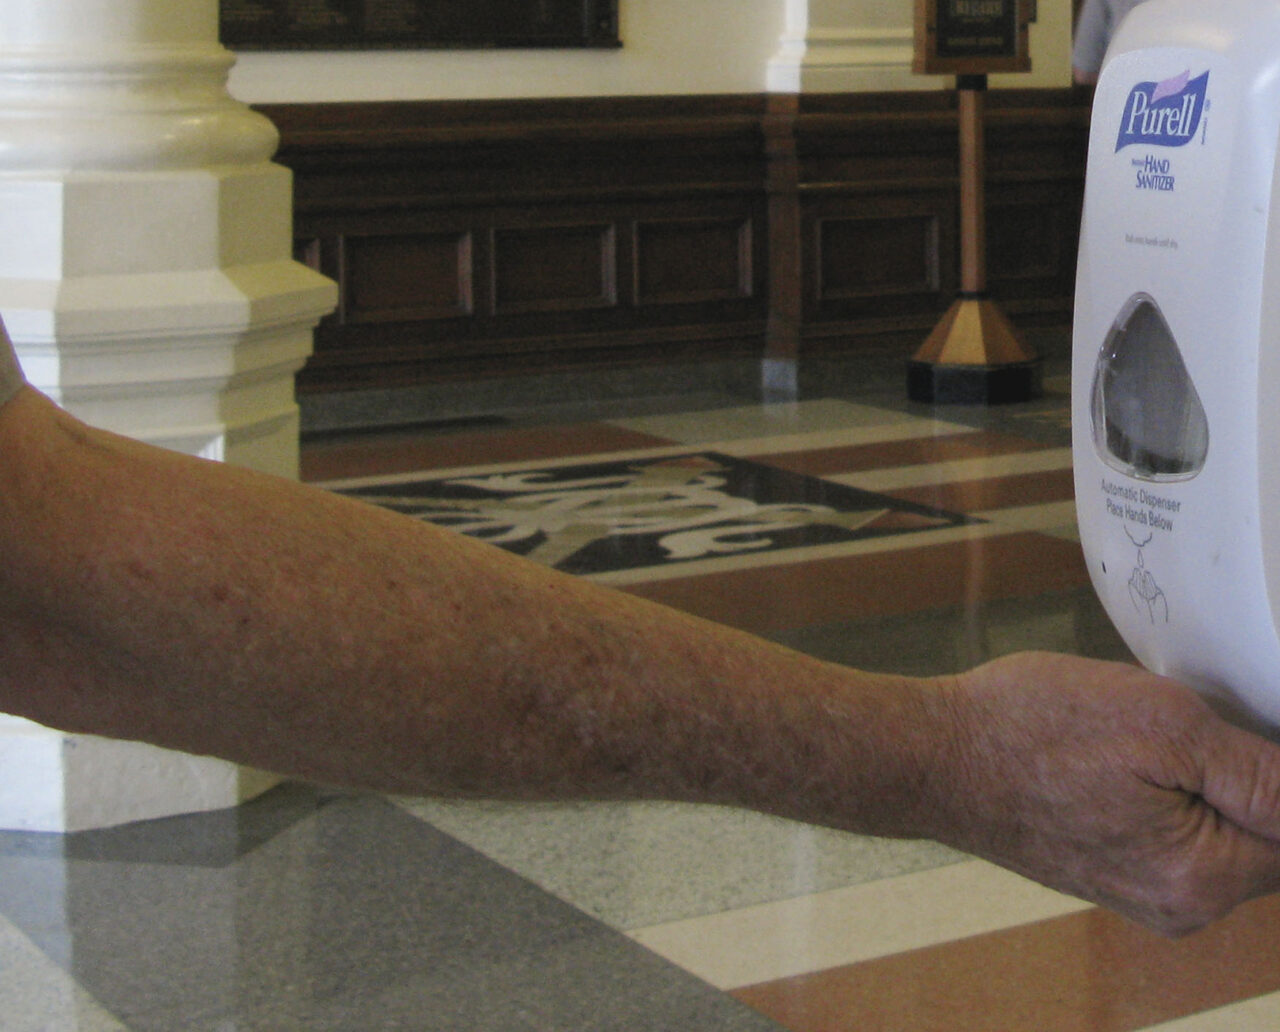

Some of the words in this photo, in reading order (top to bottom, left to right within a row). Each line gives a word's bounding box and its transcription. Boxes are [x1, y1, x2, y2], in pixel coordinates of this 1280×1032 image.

[1126, 91, 1196, 136] Purell
[1144, 154, 1170, 174] HAND
[1135, 169, 1175, 192] SANITIZER
[1101, 479, 1138, 502] Automatic
[1139, 488, 1181, 512] Dispenser
[1125, 504, 1147, 525] Hands
[1148, 509, 1174, 531] Below
